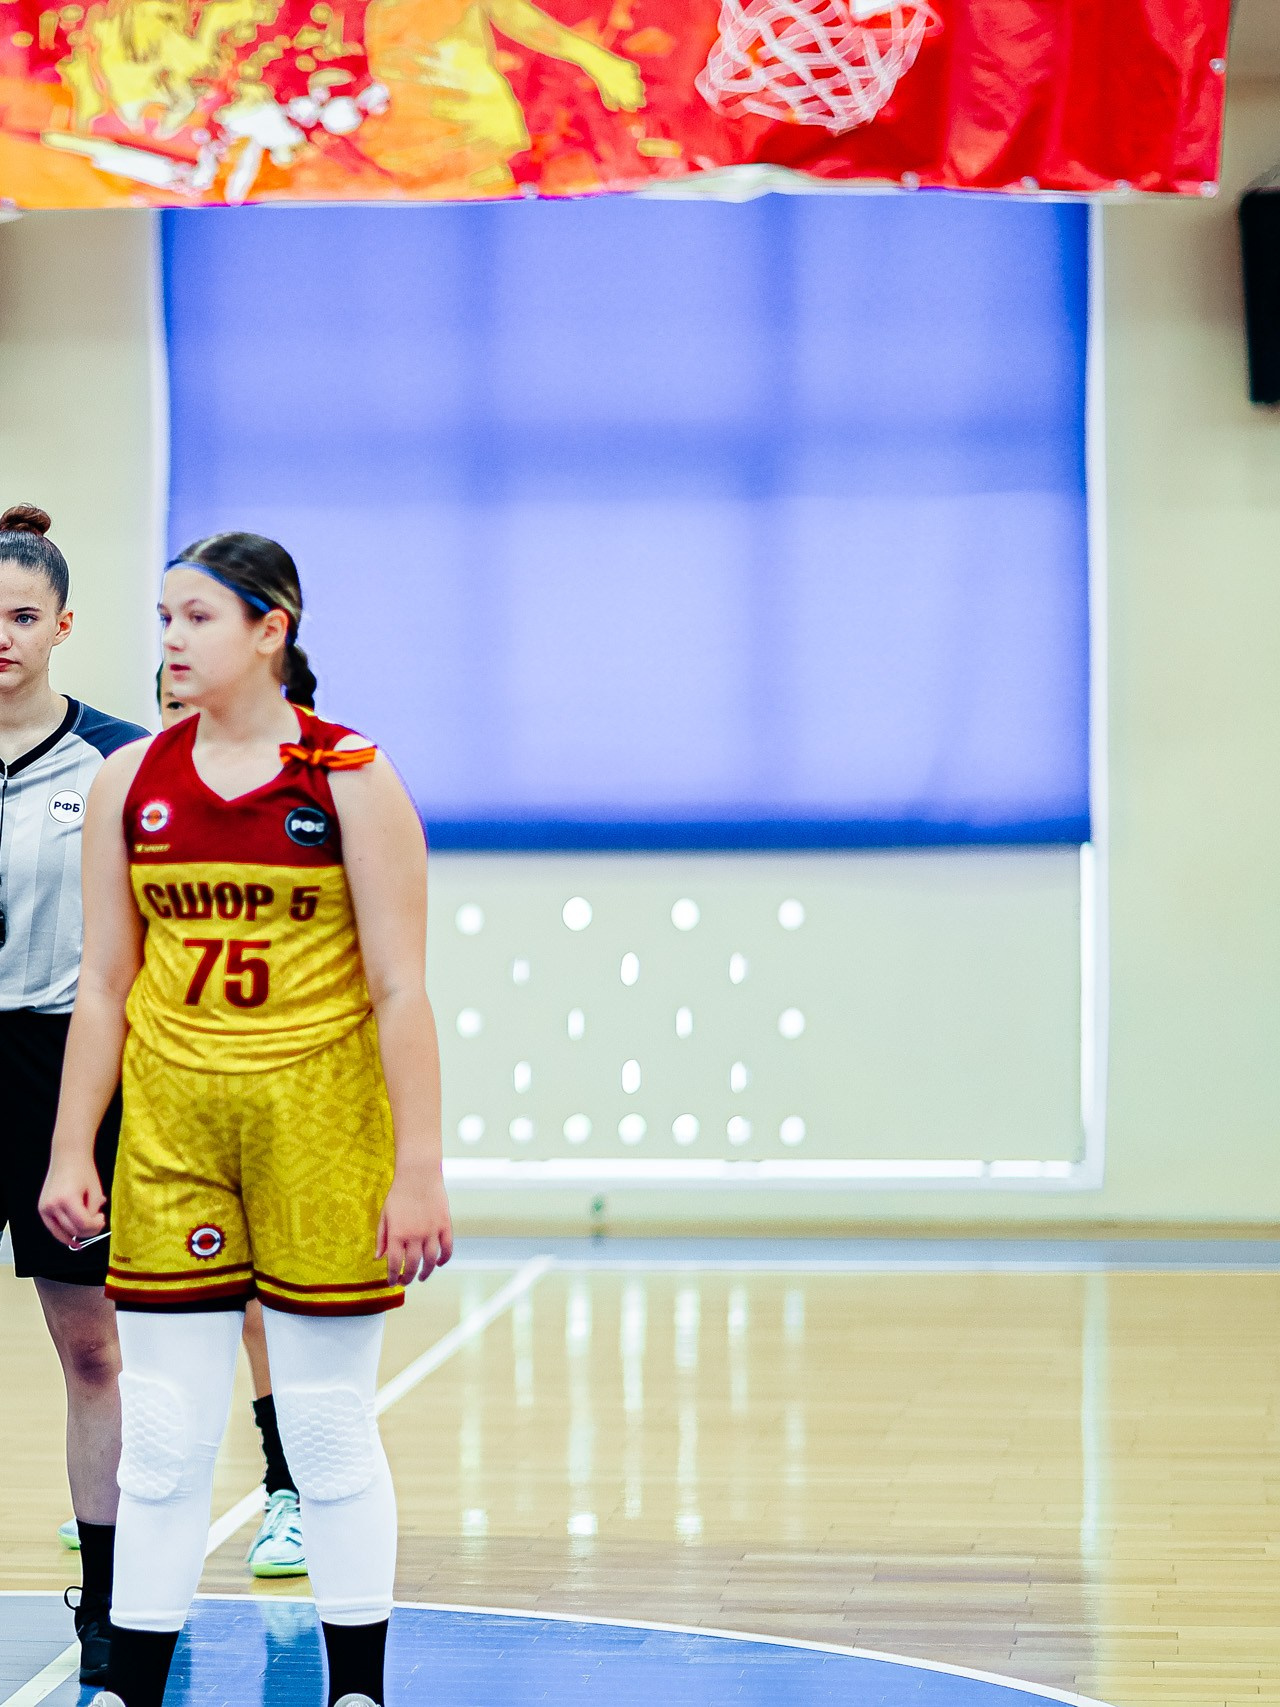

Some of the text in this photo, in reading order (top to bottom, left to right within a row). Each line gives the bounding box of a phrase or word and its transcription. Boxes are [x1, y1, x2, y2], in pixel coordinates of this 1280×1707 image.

[53, 801, 81, 813] РФБ
[143, 882, 322, 922] СШОР 5
[182, 938, 272, 1009] 75
